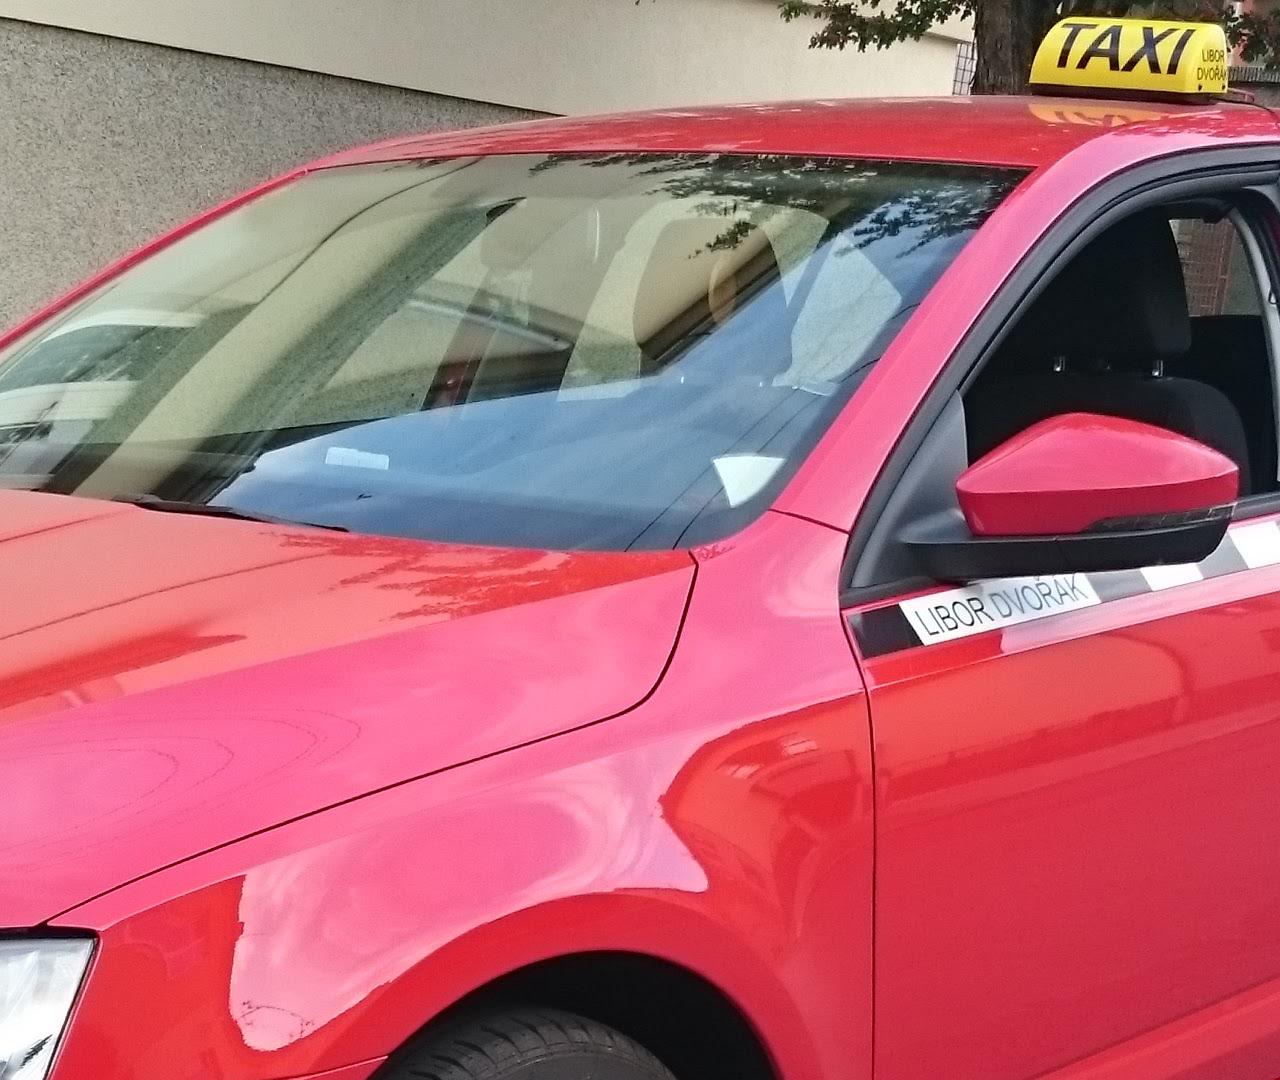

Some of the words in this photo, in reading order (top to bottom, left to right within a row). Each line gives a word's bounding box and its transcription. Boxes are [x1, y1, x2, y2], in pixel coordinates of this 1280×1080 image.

[1057, 23, 1196, 76] TAXI
[1201, 49, 1225, 62] LIBOR
[915, 597, 995, 636] LIBOR
